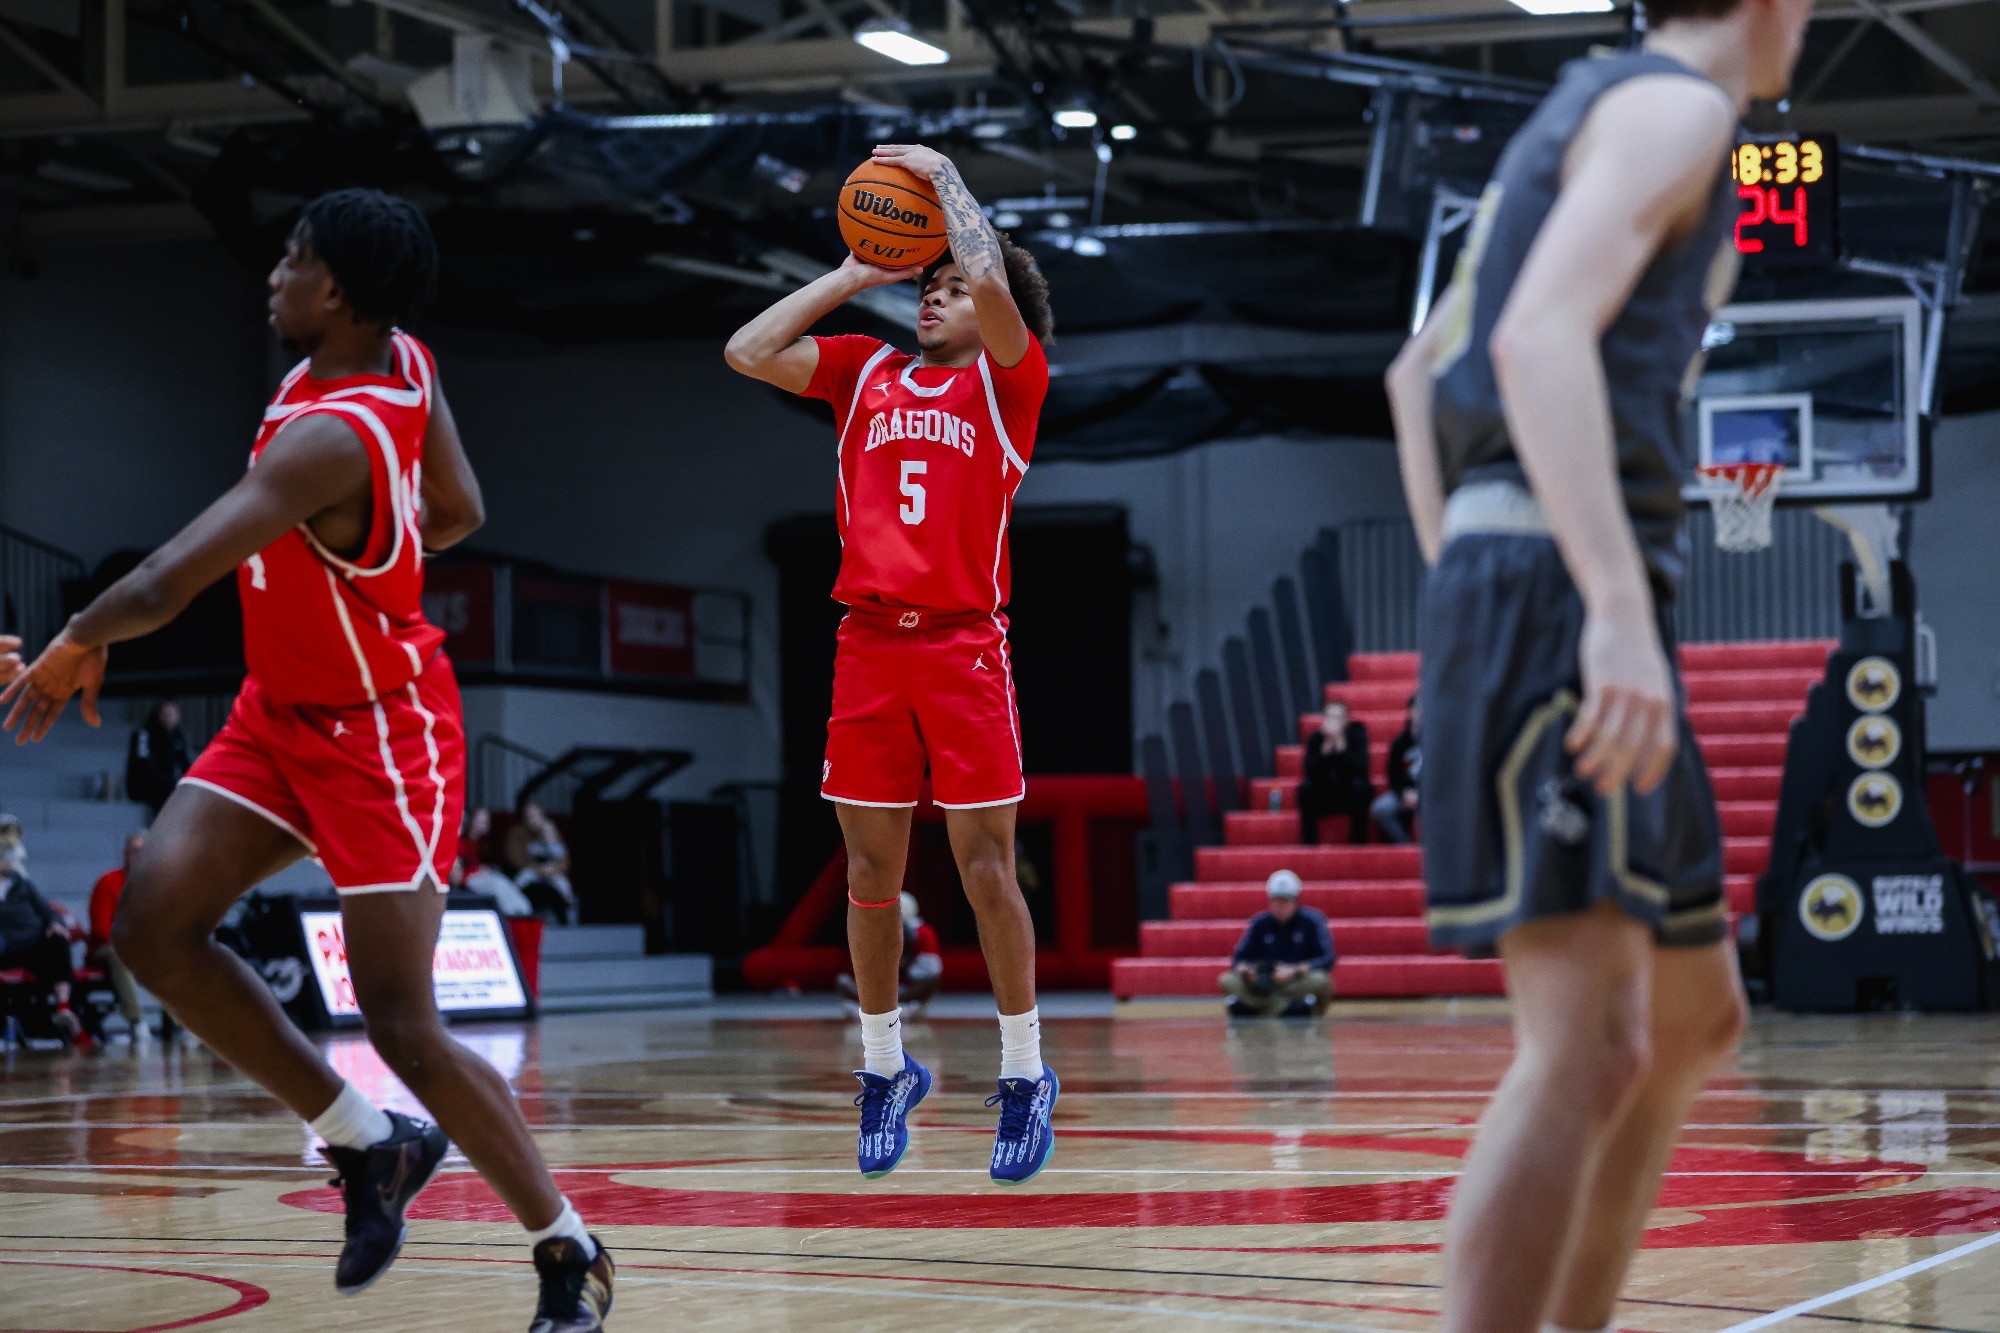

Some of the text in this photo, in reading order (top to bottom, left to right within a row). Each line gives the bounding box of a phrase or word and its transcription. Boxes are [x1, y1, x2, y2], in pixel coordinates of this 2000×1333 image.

[852, 189, 929, 230] Wilson
[1734, 184, 1808, 253] 24
[864, 407, 976, 458] DRAGONS
[899, 460, 927, 526] 5
